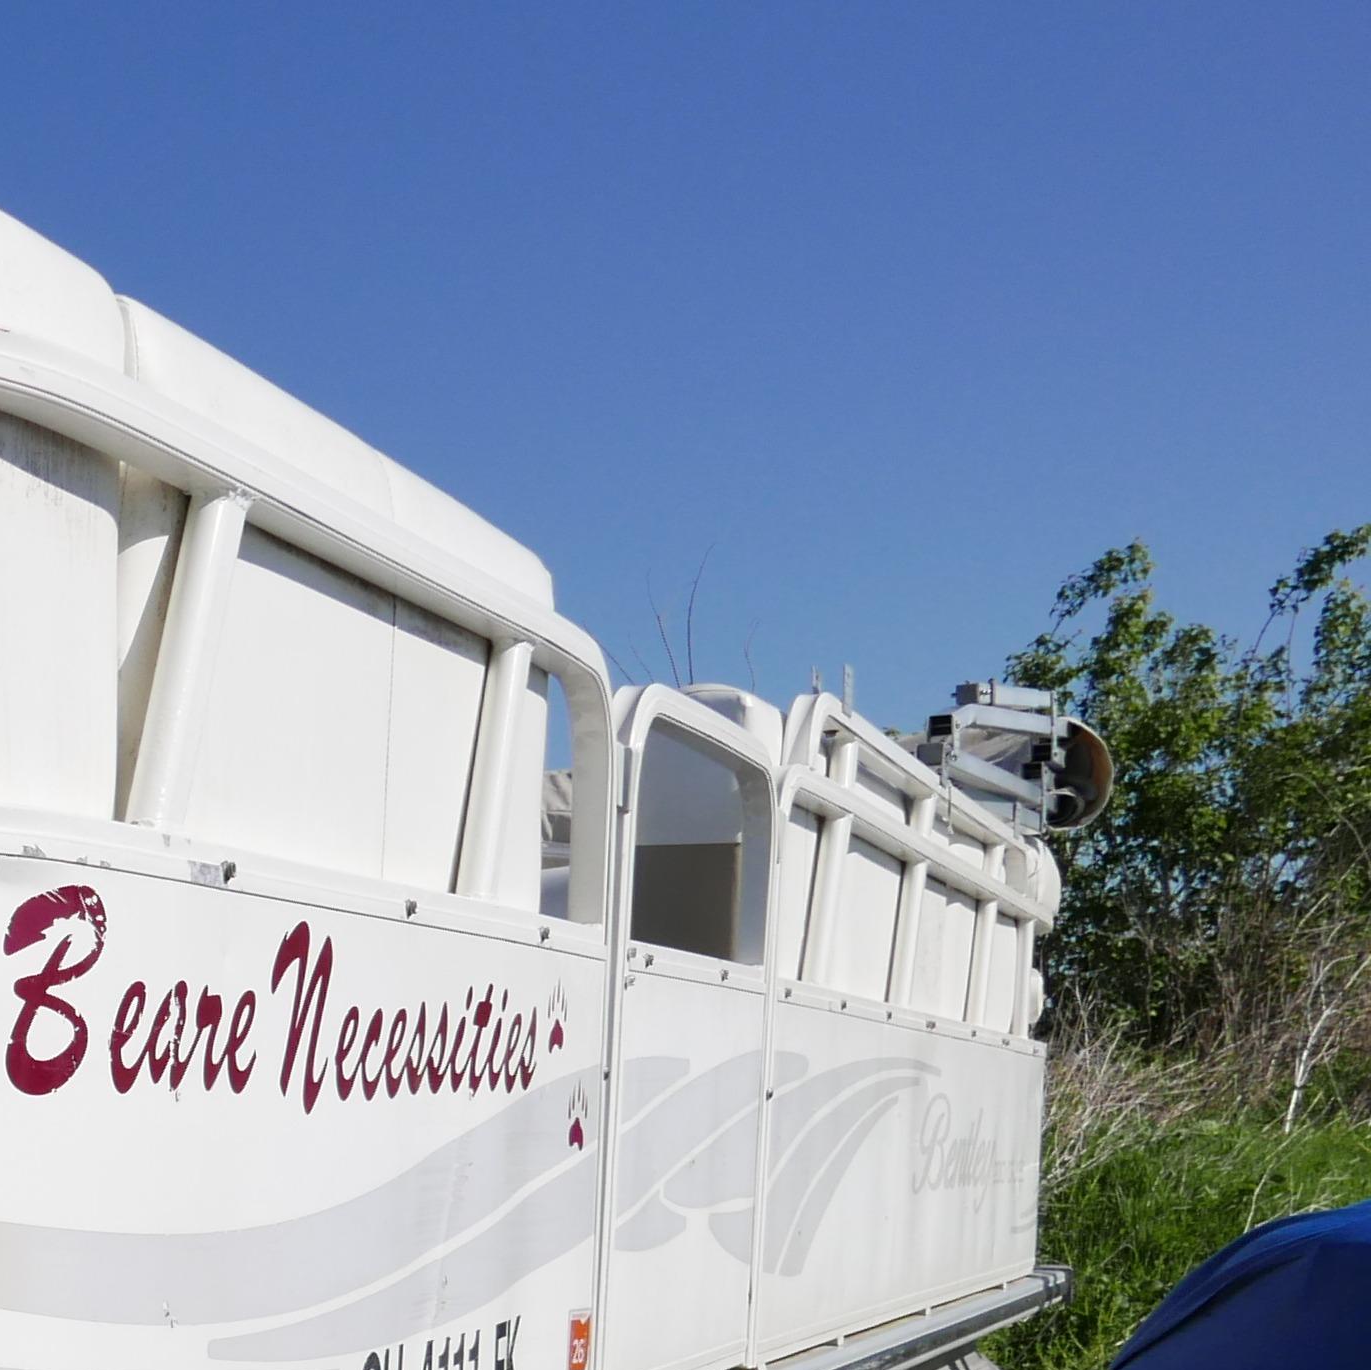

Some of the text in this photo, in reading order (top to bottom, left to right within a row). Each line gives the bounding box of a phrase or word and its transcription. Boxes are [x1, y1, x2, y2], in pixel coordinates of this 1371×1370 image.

[3, 884, 538, 1115] Beare Necessities
[912, 1092, 997, 1214] Bentley
